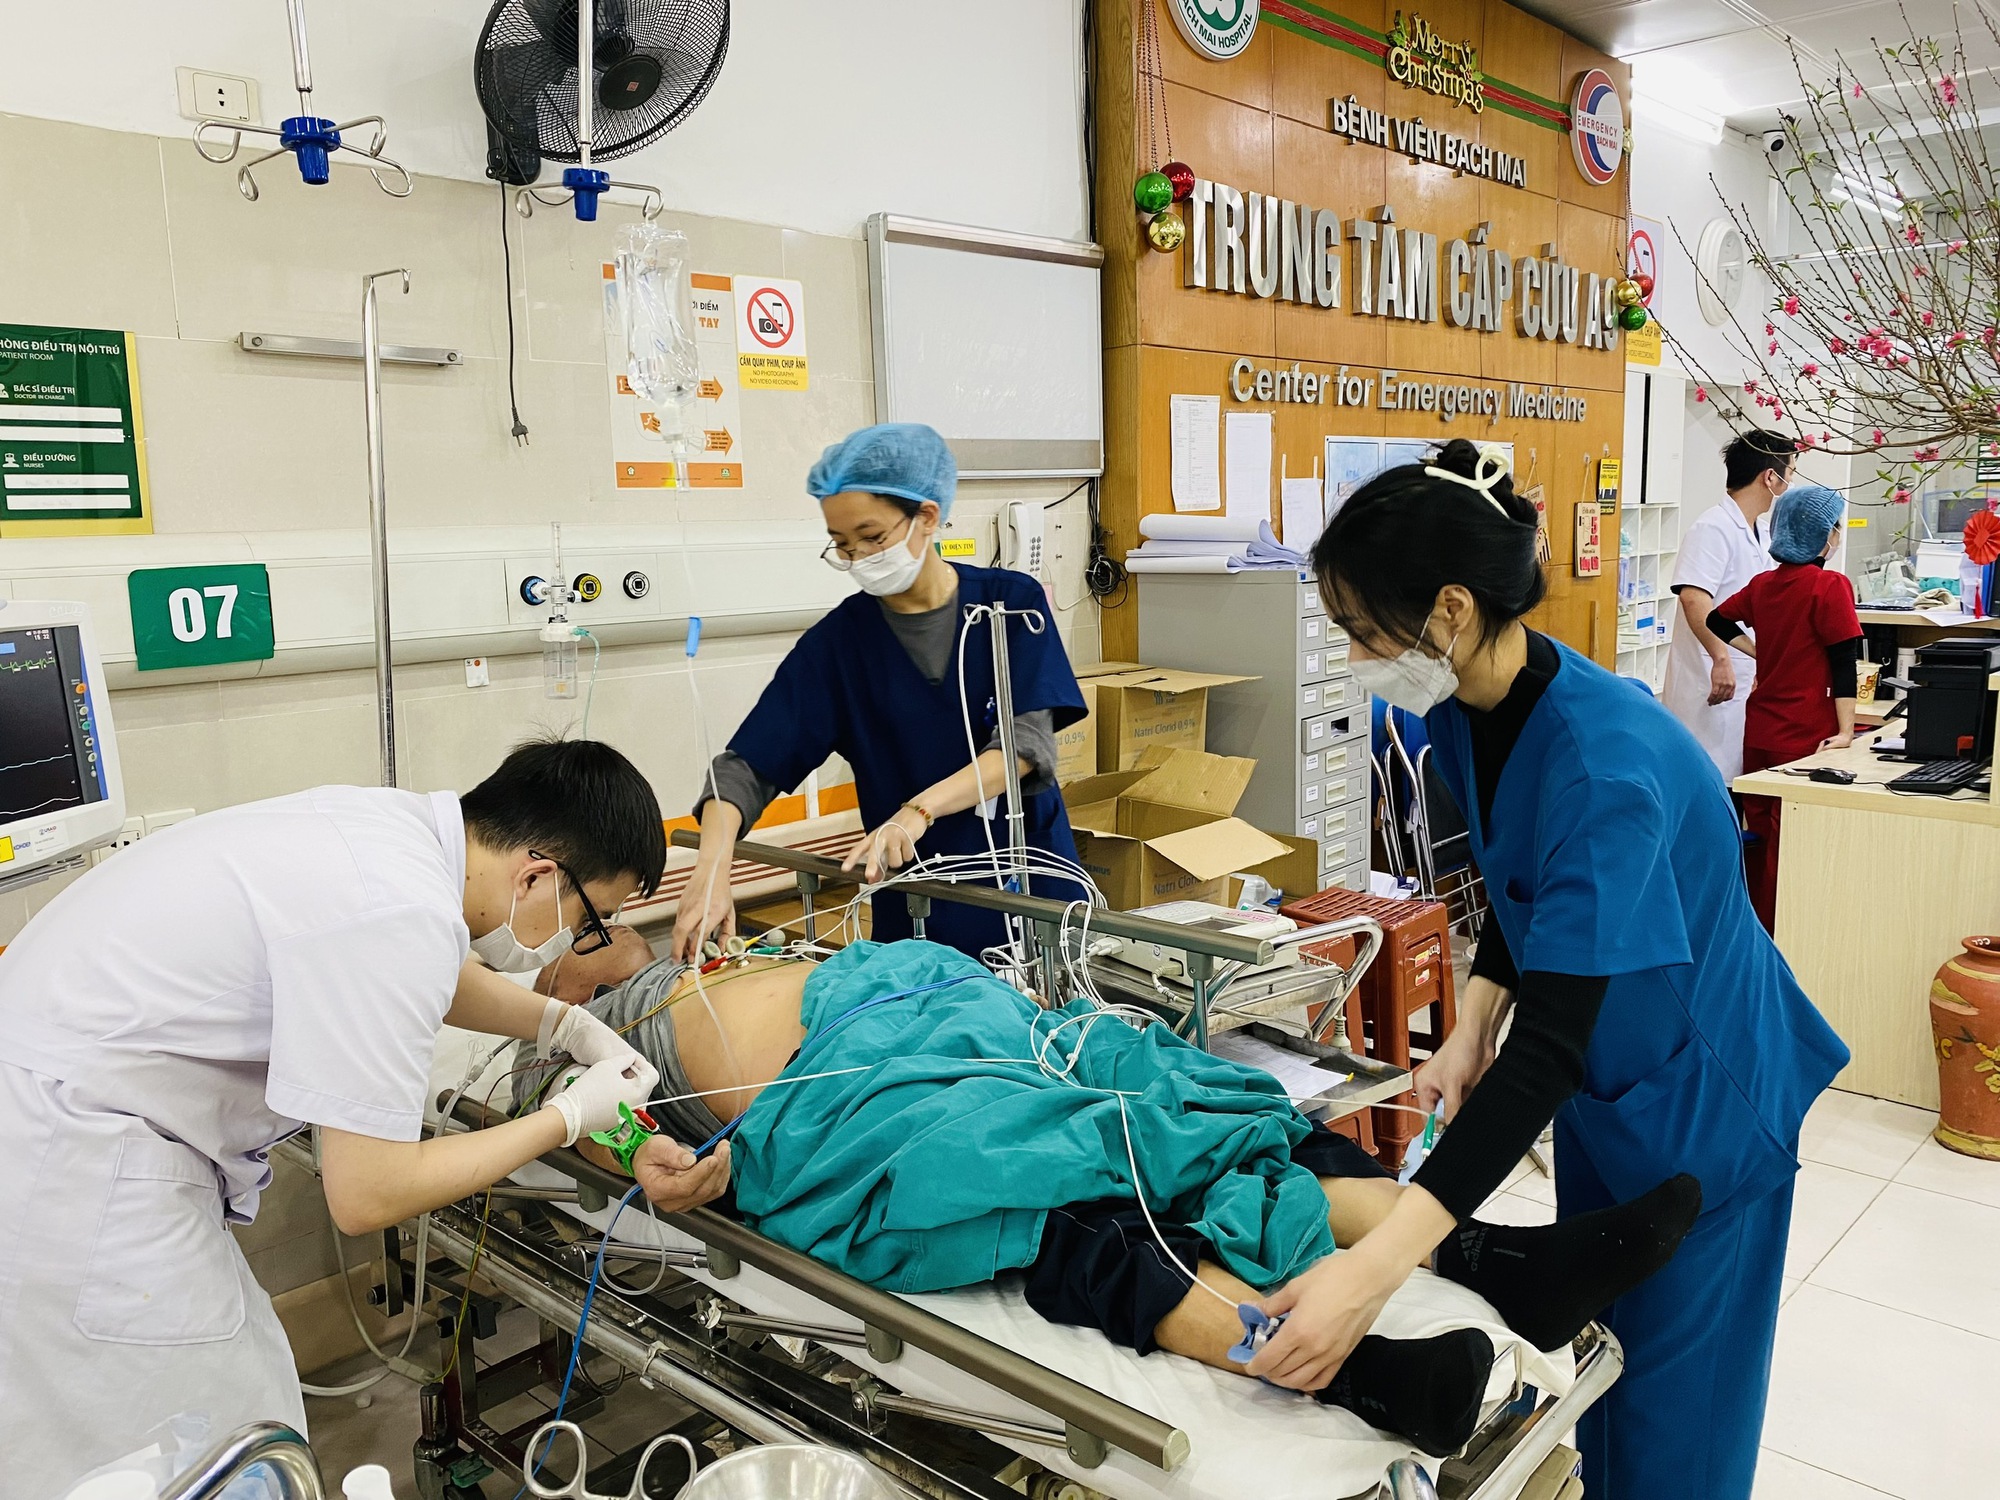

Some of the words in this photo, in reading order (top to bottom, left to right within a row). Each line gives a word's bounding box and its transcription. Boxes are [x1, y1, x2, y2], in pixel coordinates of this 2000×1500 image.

[1198, 25, 1216, 46] MAI
[1217, 14, 1253, 48] HOSPITAL
[1411, 14, 1471, 81] Merry
[1390, 46, 1484, 113] Christmas
[1577, 115, 1618, 138] EMERGENCY
[1332, 94, 1389, 146] BỆNH
[1394, 118, 1441, 164] VIỆN
[1444, 133, 1493, 178] BẠCH
[1496, 150, 1527, 188] MAI
[1609, 140, 1618, 151] MAI
[1187, 178, 1341, 308] TRUNG
[1350, 204, 1438, 322] TÂM
[1446, 221, 1513, 332] CẤP
[1518, 241, 1580, 344] CỨU
[1583, 272, 1619, 352] A9
[698, 316, 719, 329] TAY
[29, 352, 54, 361] ROOM
[59, 342, 76, 355] TRỊ
[78, 343, 98, 355] NỘI
[99, 344, 120, 354] TRÚ
[752, 357, 766, 368] QUAY
[761, 370, 795, 378] PHOTOGRAPHY
[1231, 357, 1330, 405] Center
[1335, 365, 1375, 407] for
[1379, 370, 1504, 425] Emergency
[1507, 382, 1587, 422] Medicine
[168, 584, 238, 642] 07
[1064, 731, 1086, 745] 0,9%
[1134, 728, 1153, 738] Natri
[1154, 722, 1177, 735] Clorid
[1153, 881, 1176, 896] Natri
